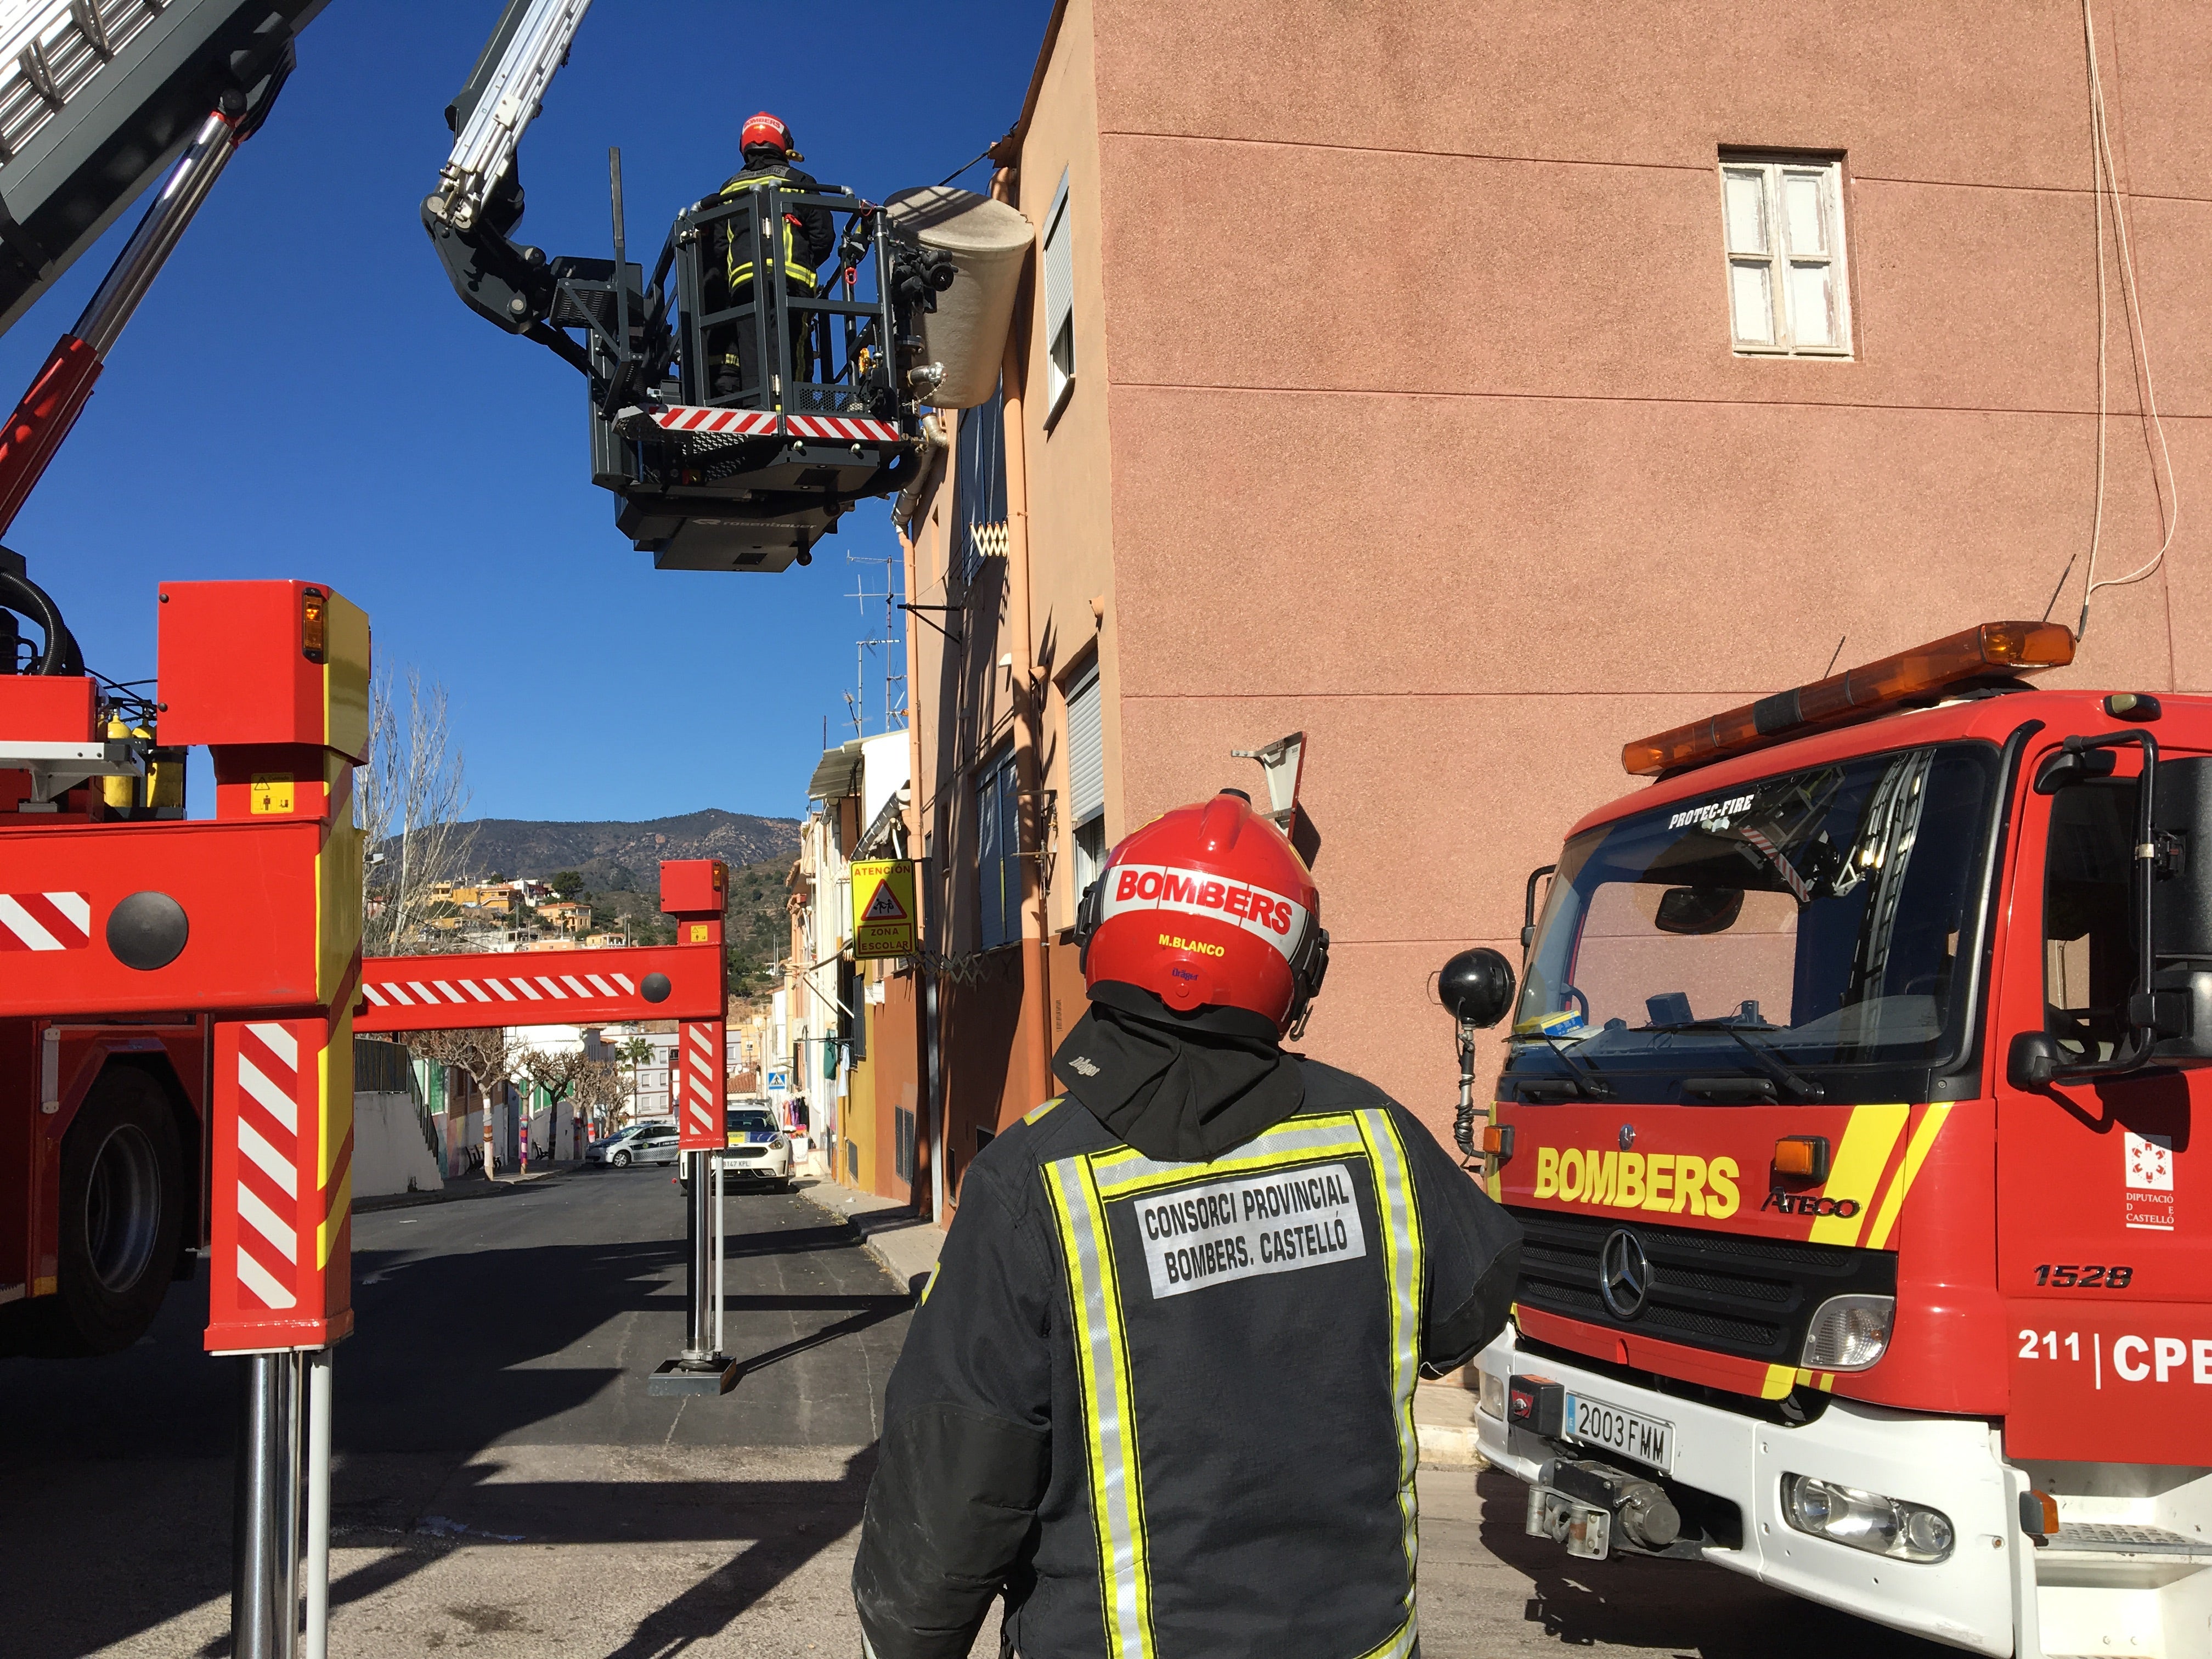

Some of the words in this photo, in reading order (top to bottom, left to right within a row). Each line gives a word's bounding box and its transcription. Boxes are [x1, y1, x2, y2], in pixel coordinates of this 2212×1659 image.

[1668, 794, 1754, 830] PROTEC-FIRE
[854, 863, 911, 876] ATENCIÓN
[1116, 870, 1293, 935] BOMBERS
[871, 928, 899, 936] ZONA
[861, 941, 909, 950] ESCOLAR
[1159, 934, 1225, 957] M.BLANCO
[1172, 967, 1199, 981] Dräger
[1534, 1147, 1740, 1219] BOMBERS
[1144, 1192, 1238, 1241] CONSORCI
[1242, 1174, 1350, 1222] PROVINCIAL
[2126, 1193, 2174, 1204] DIPUTACIÓ
[2126, 1213, 2174, 1224] CASTELLÓ
[1164, 1235, 1254, 1285] BOMBERS.
[1260, 1210, 1348, 1263] CASTELLÓ
[2034, 1264, 2134, 1289] 1528
[2018, 1329, 2080, 1361] 211
[1579, 1403, 1624, 1447] 2003
[1628, 1419, 1664, 1464] FMM
